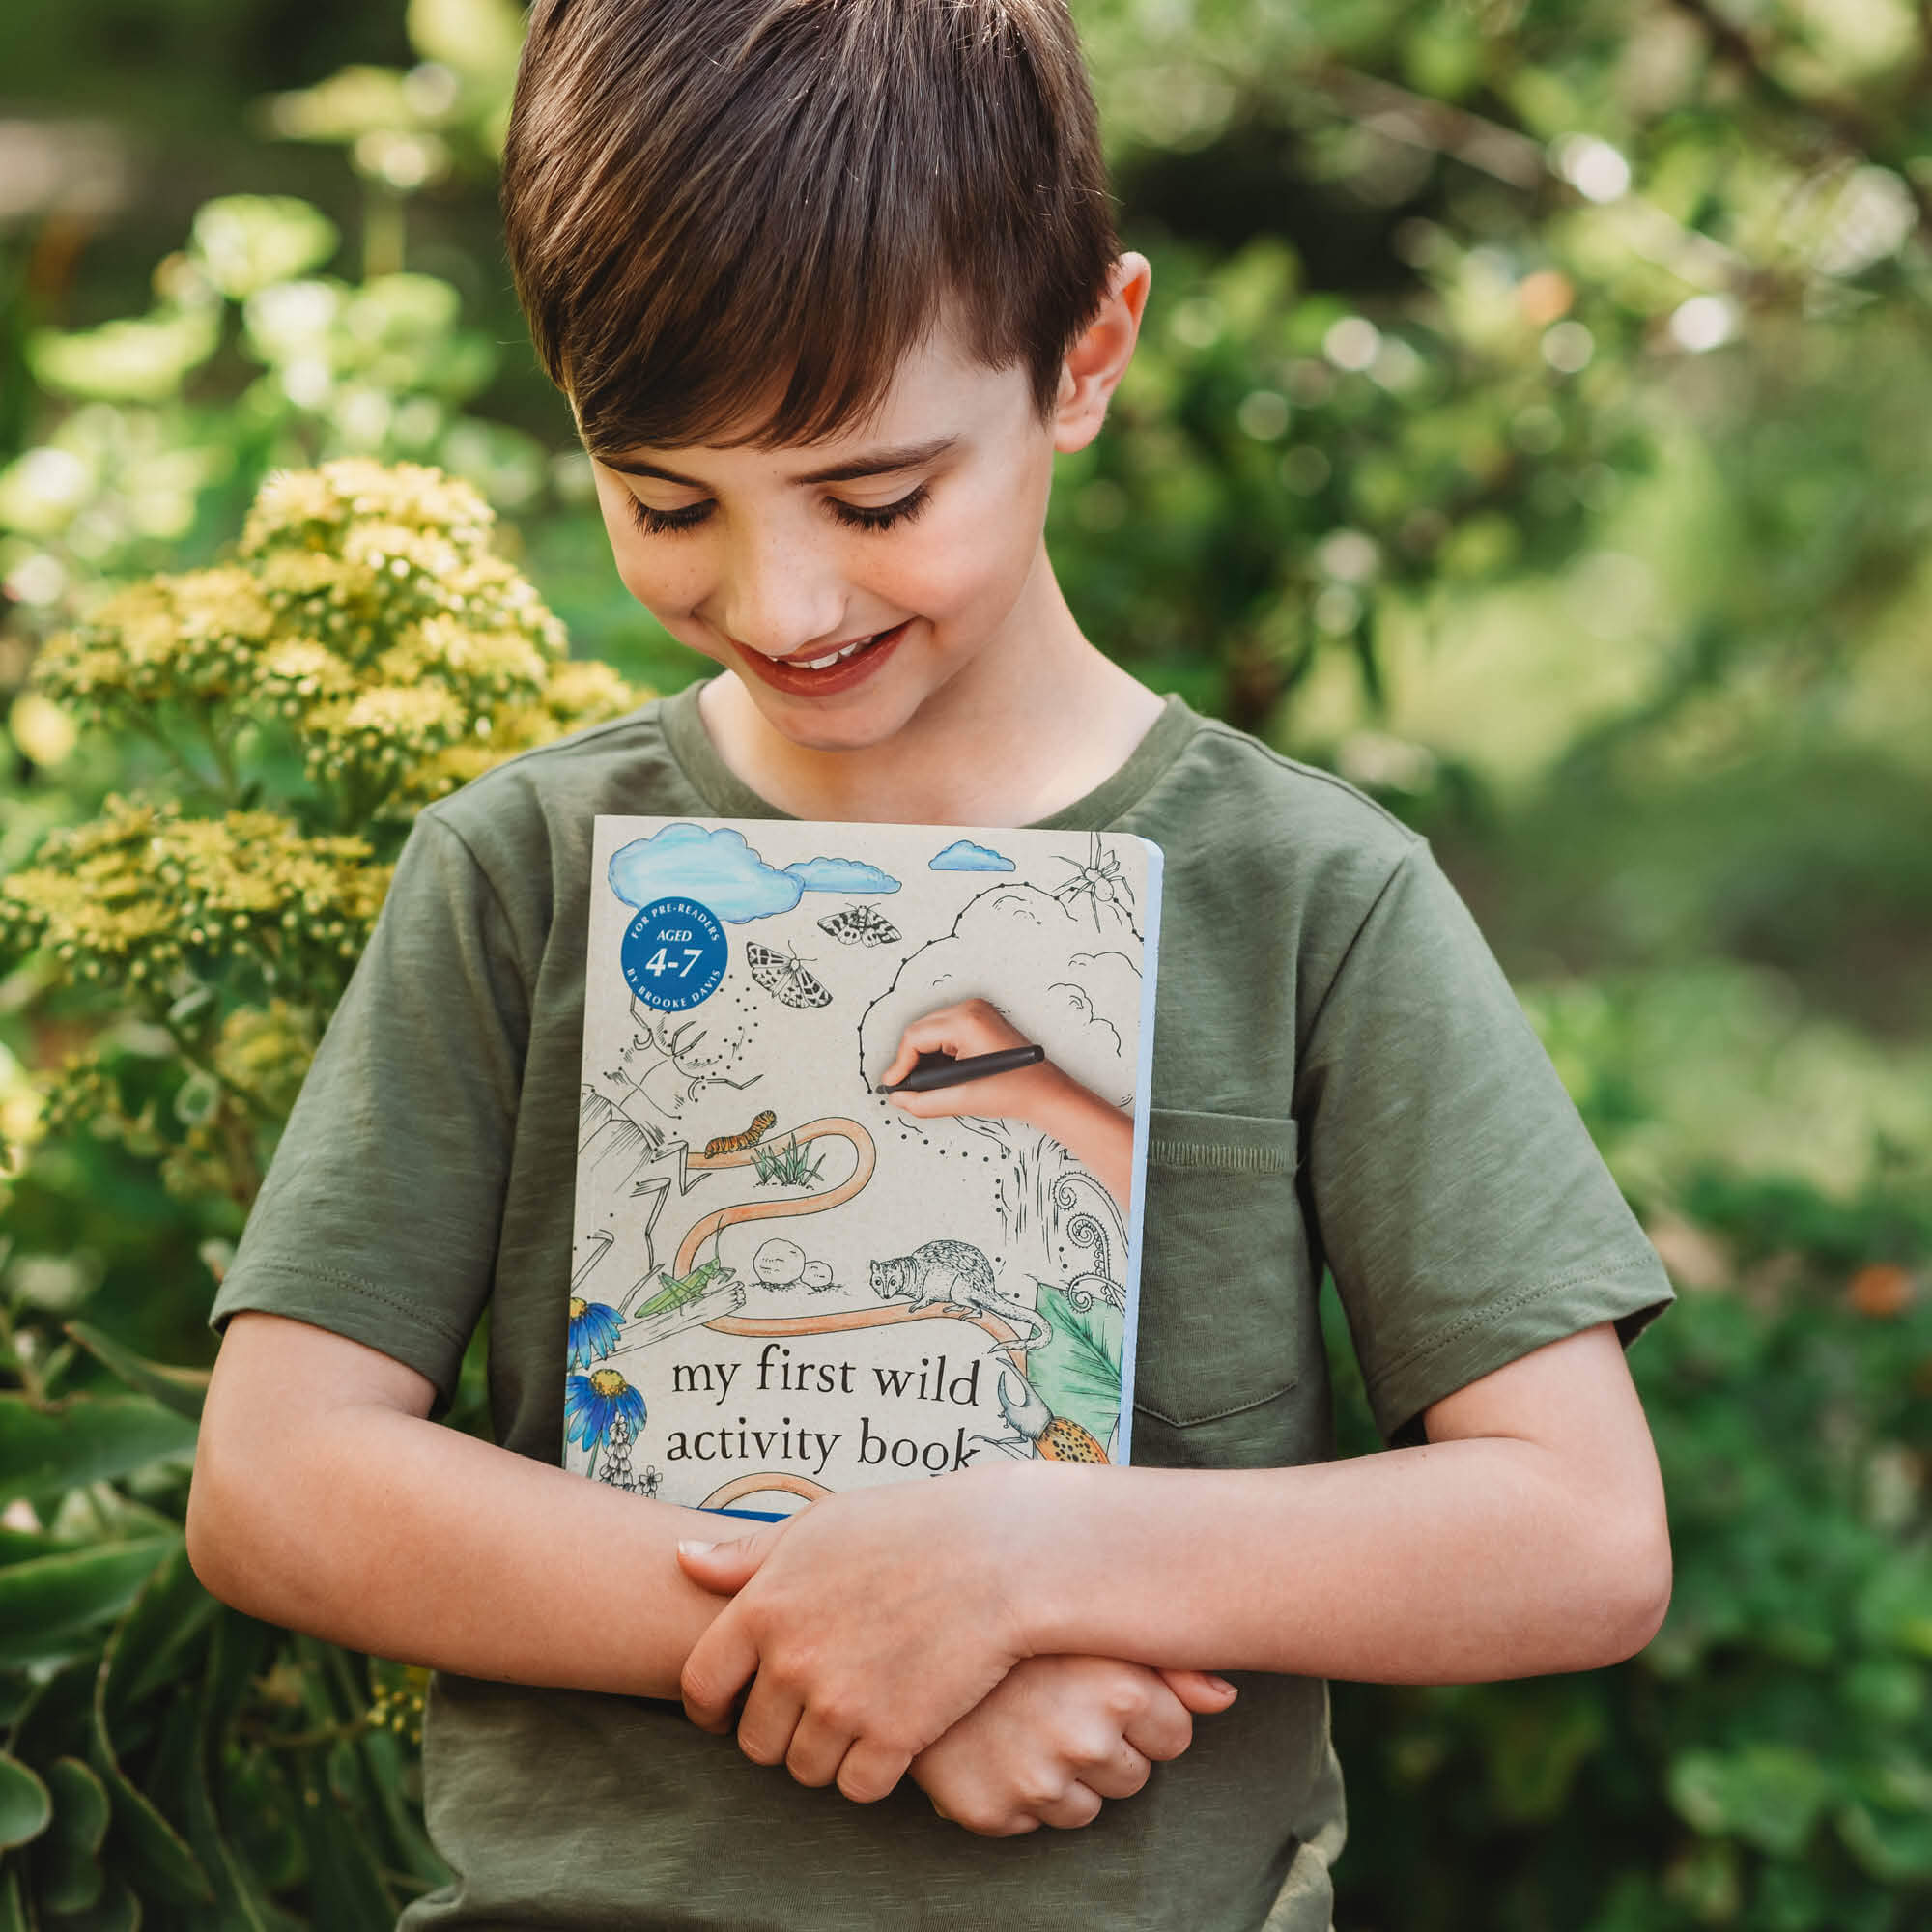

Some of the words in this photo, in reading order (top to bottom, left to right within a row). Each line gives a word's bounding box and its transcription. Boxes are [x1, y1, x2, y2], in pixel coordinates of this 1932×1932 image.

[631, 916, 649, 939] FOR
[651, 903, 720, 942] PRE-READERS
[657, 929, 693, 942] AGED
[645, 948, 704, 977] 4-7
[627, 967, 639, 983] BY
[638, 985, 687, 1008] BROOKE
[691, 969, 721, 1003] DAVIS
[672, 1361, 742, 1406] my
[756, 1343, 856, 1394] first
[872, 1355, 980, 1406] wild
[667, 1417, 842, 1475] activity
[858, 1417, 981, 1473] book
